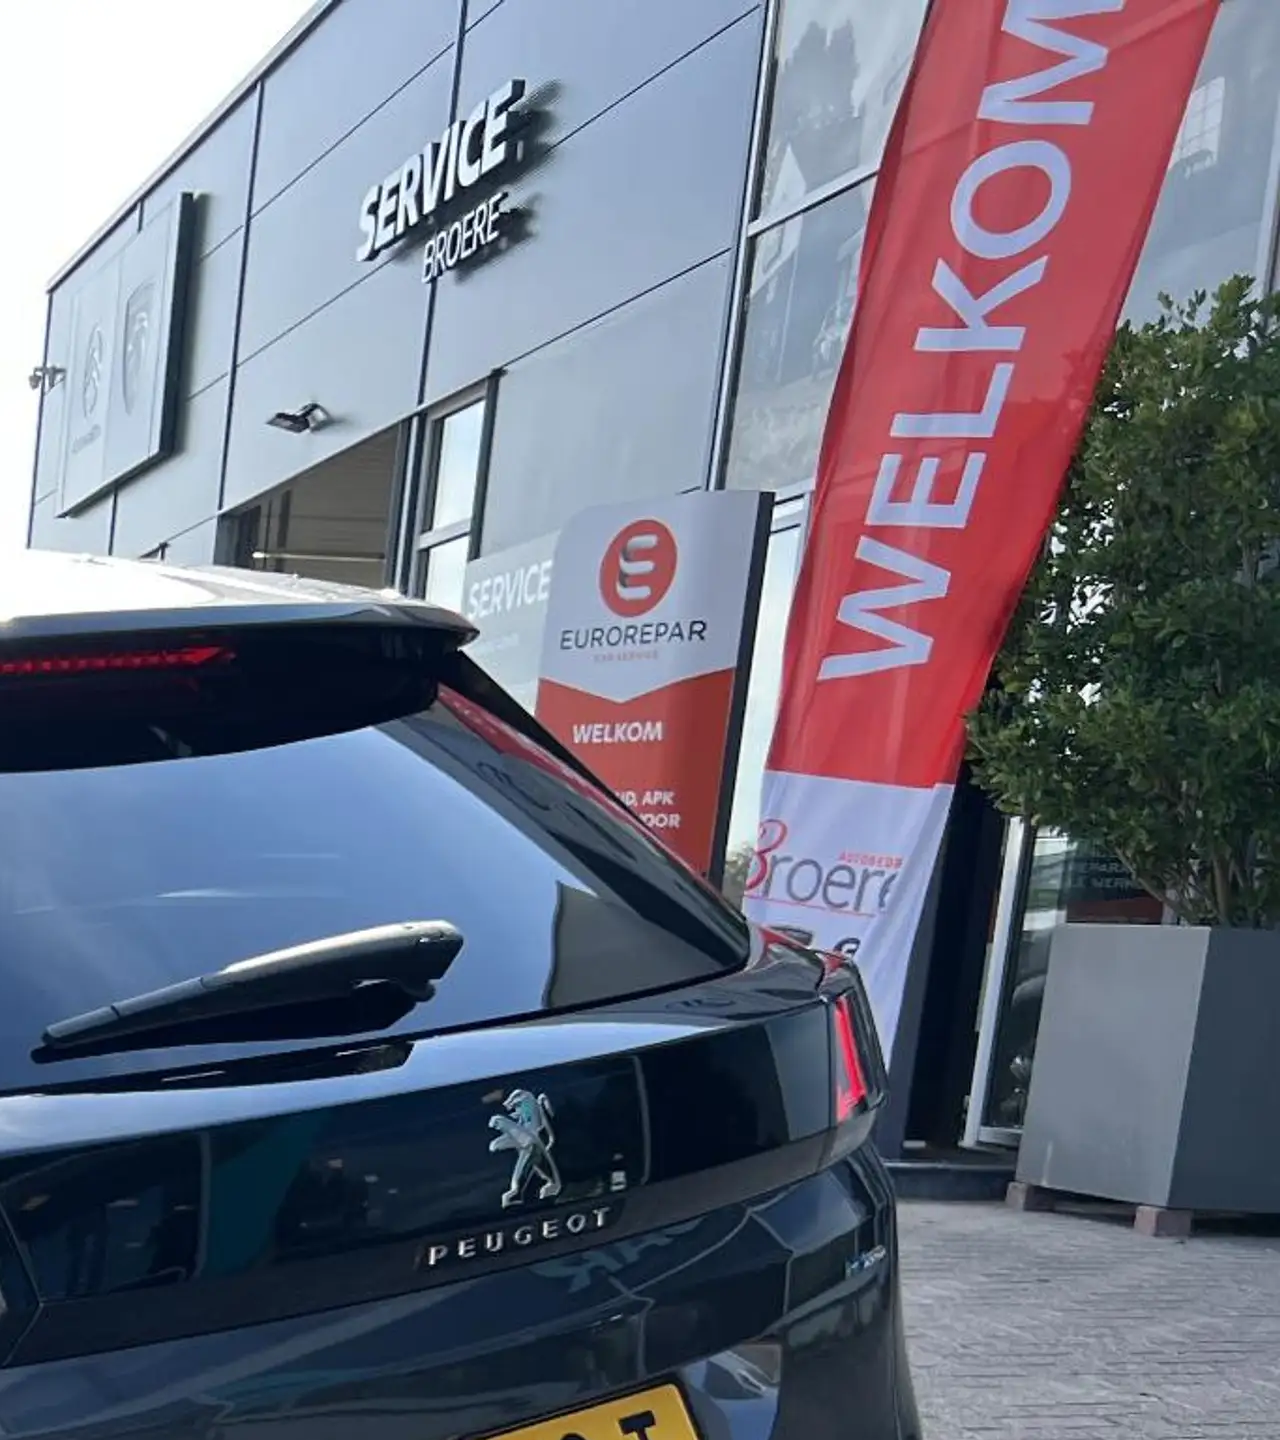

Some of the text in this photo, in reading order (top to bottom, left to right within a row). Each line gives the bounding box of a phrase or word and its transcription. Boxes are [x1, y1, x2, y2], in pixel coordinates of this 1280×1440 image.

[356, 79, 525, 262] SERVICE
[421, 191, 509, 284] BROERE
[817, 0, 1126, 681] WELKOM
[466, 559, 554, 622] SERVICE
[559, 619, 708, 651] EUROREPAR
[572, 720, 663, 744] WELKOM
[642, 790, 676, 806] APK
[427, 1205, 611, 1267] PEUGEOT
